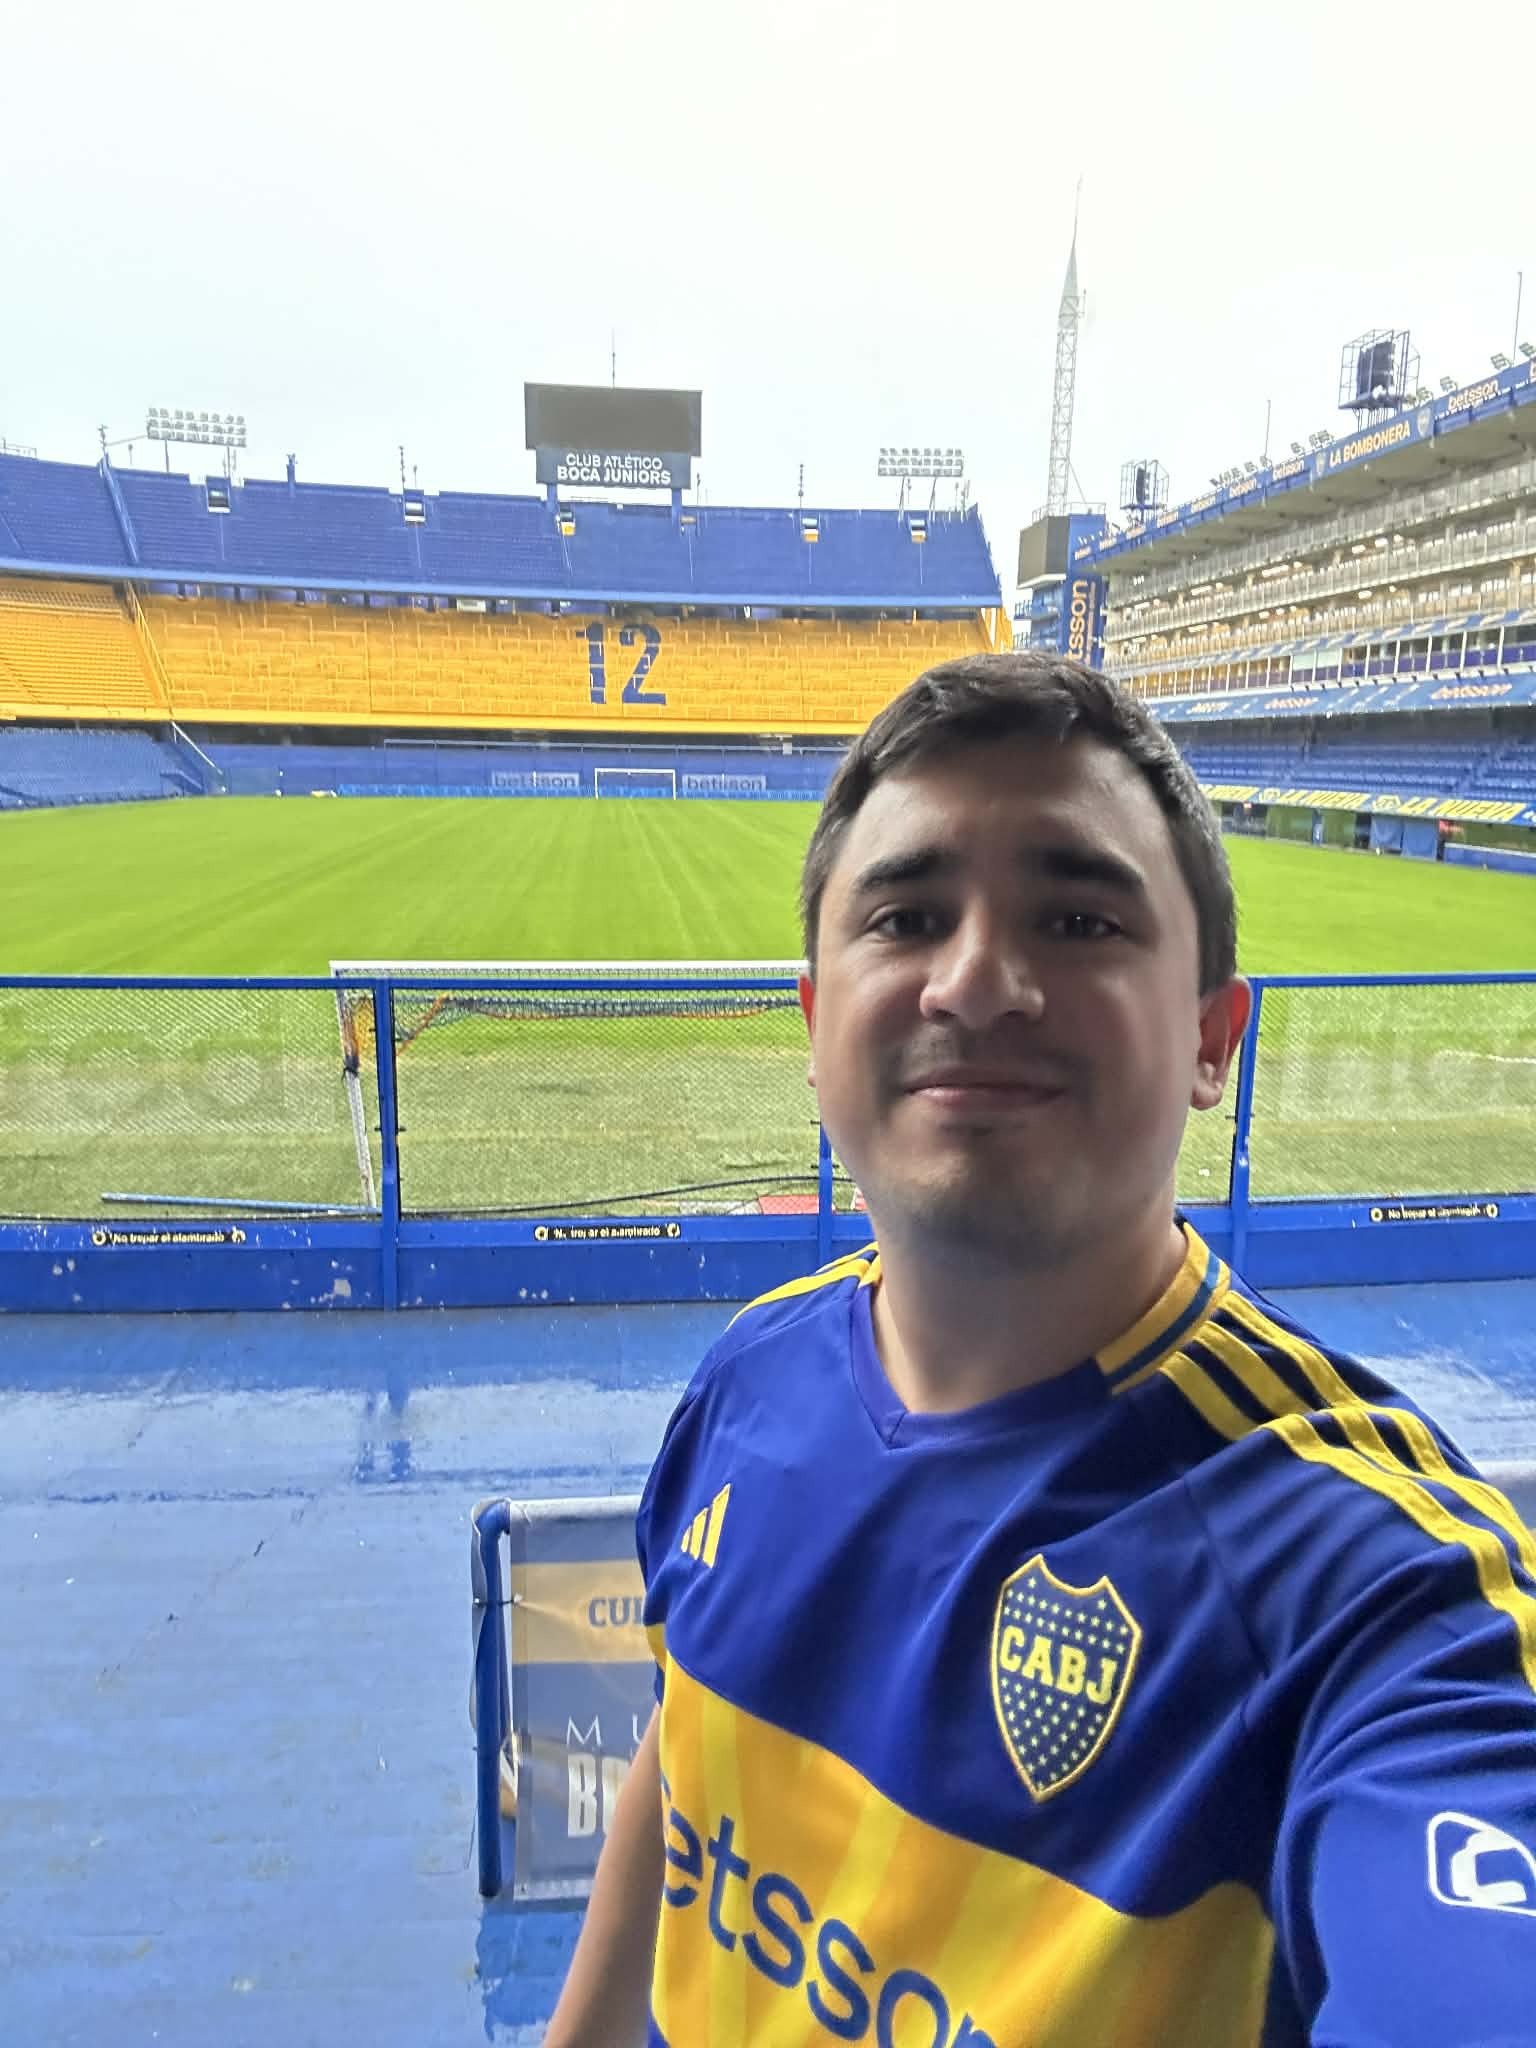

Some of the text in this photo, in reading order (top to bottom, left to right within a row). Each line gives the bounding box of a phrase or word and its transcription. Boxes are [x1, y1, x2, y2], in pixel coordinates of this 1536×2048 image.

[1448, 379, 1498, 411] betsson
[566, 453, 663, 471] CLUB ATLÉTICO
[1329, 421, 1411, 468] LA BOMBONERA
[557, 466, 671, 485] BOCA JUNIORS
[1067, 580, 1089, 662] tsson
[575, 622, 667, 705] 12
[160, 1231, 171, 1244] el
[1000, 1625, 1118, 1705] CABJ
